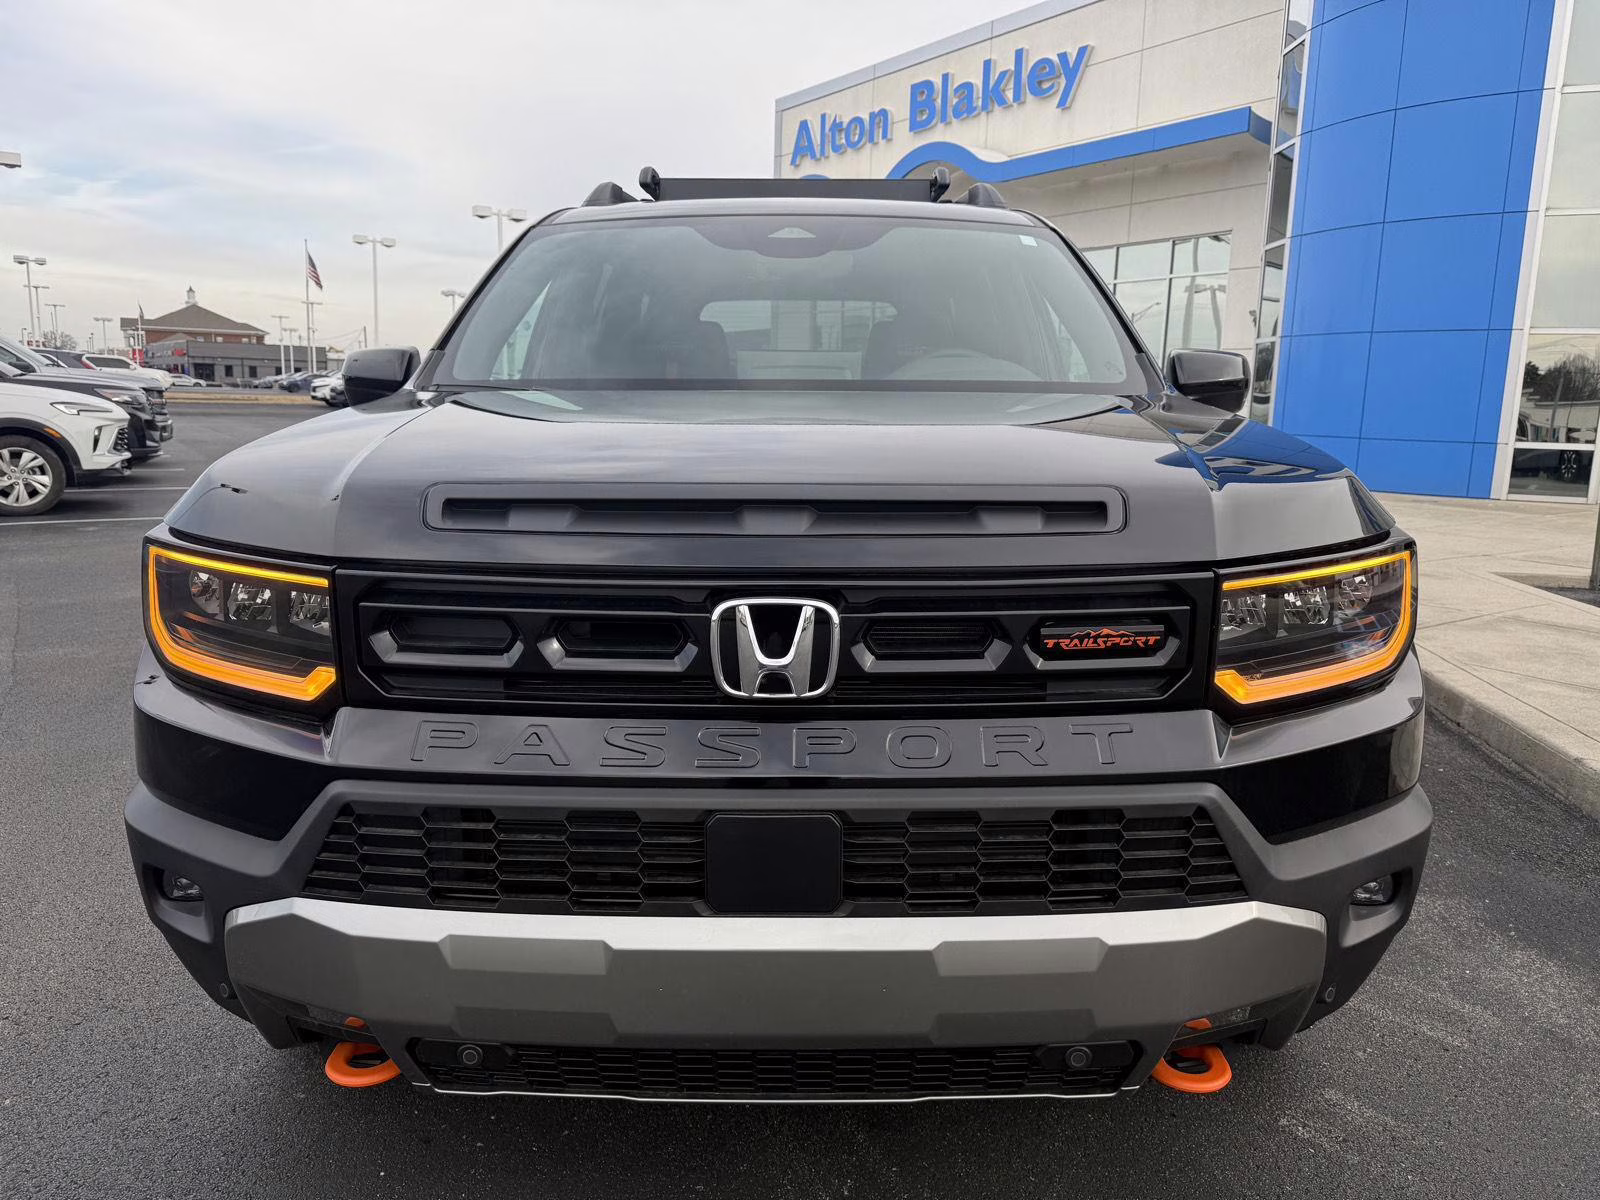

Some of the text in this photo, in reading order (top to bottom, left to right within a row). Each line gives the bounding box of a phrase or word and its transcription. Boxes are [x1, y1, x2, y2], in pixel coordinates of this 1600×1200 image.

[790, 44, 1094, 168] Alton Blakley
[1043, 635, 1161, 651] TRAILSPORT
[409, 719, 1134, 769] PASSPORT
